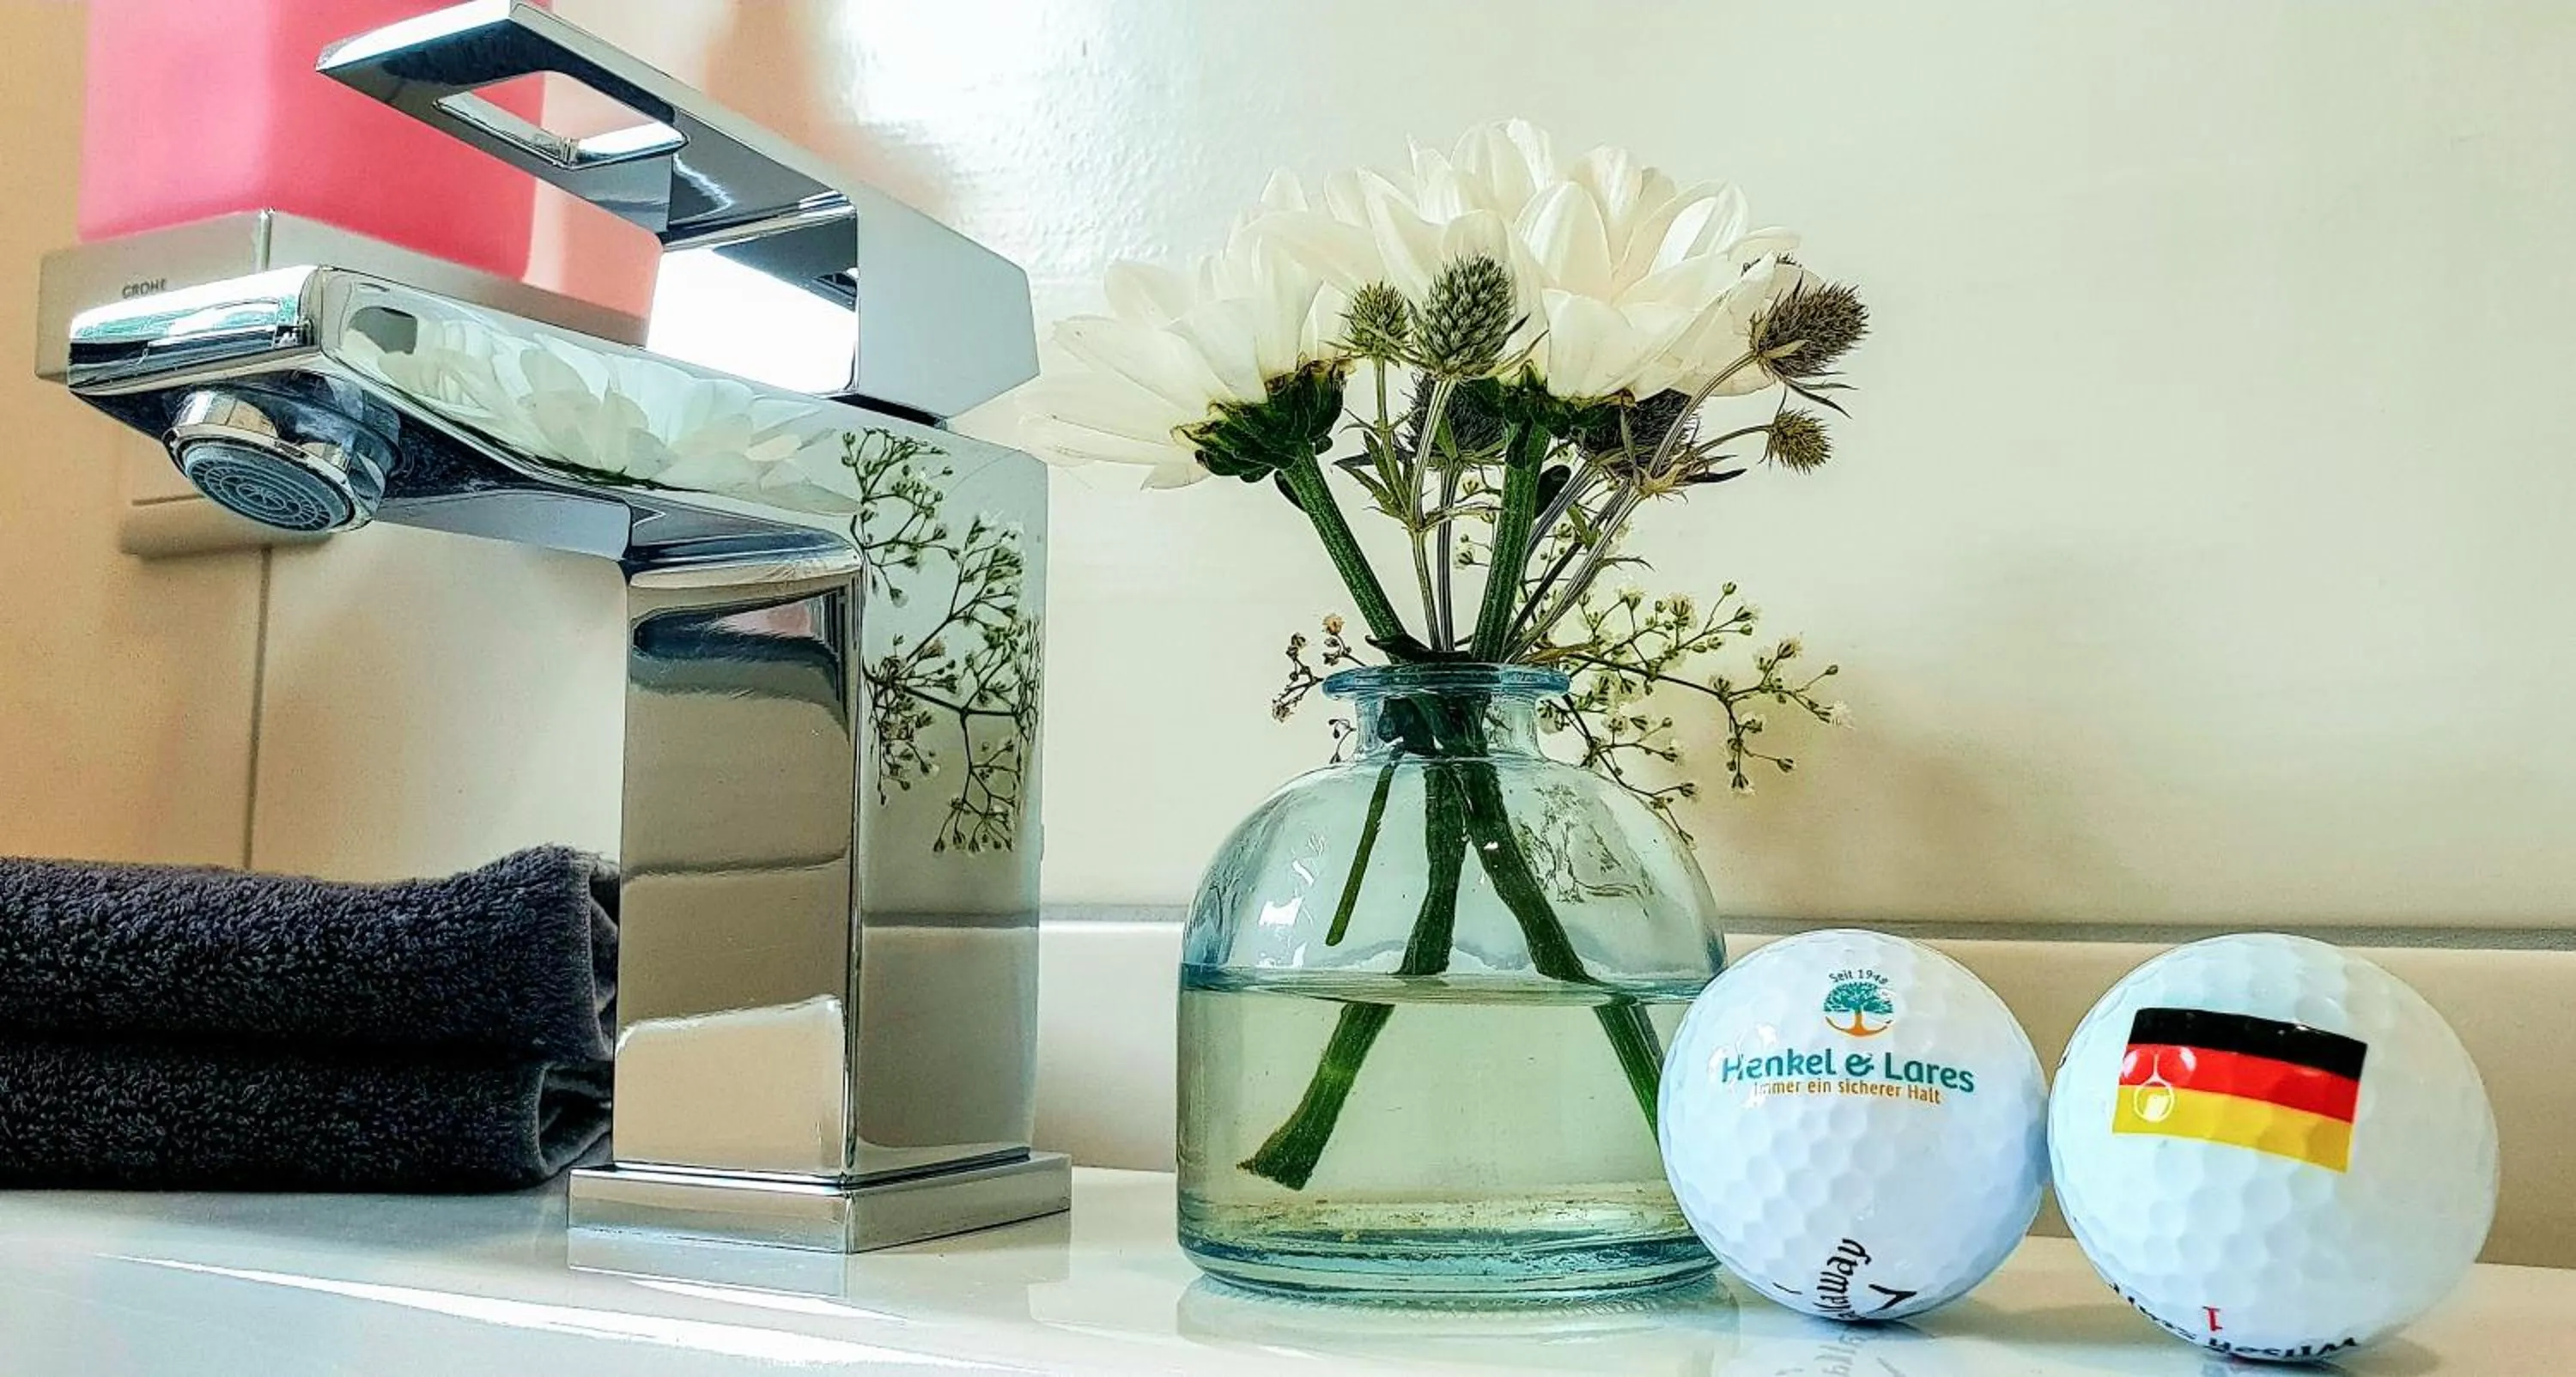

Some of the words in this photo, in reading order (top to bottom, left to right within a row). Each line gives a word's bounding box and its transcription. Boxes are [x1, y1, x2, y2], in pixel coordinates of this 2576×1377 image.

[121, 277, 167, 299] GROHE
[1828, 968, 1853, 982] Seit
[1721, 1048, 1837, 1083] Henkel
[1845, 1053, 1874, 1077] &
[1885, 1052, 1975, 1093] Lares
[1807, 1077, 1832, 1093] ein
[1838, 1078, 1901, 1098] sicherer
[1907, 1084, 1941, 1105] Halt
